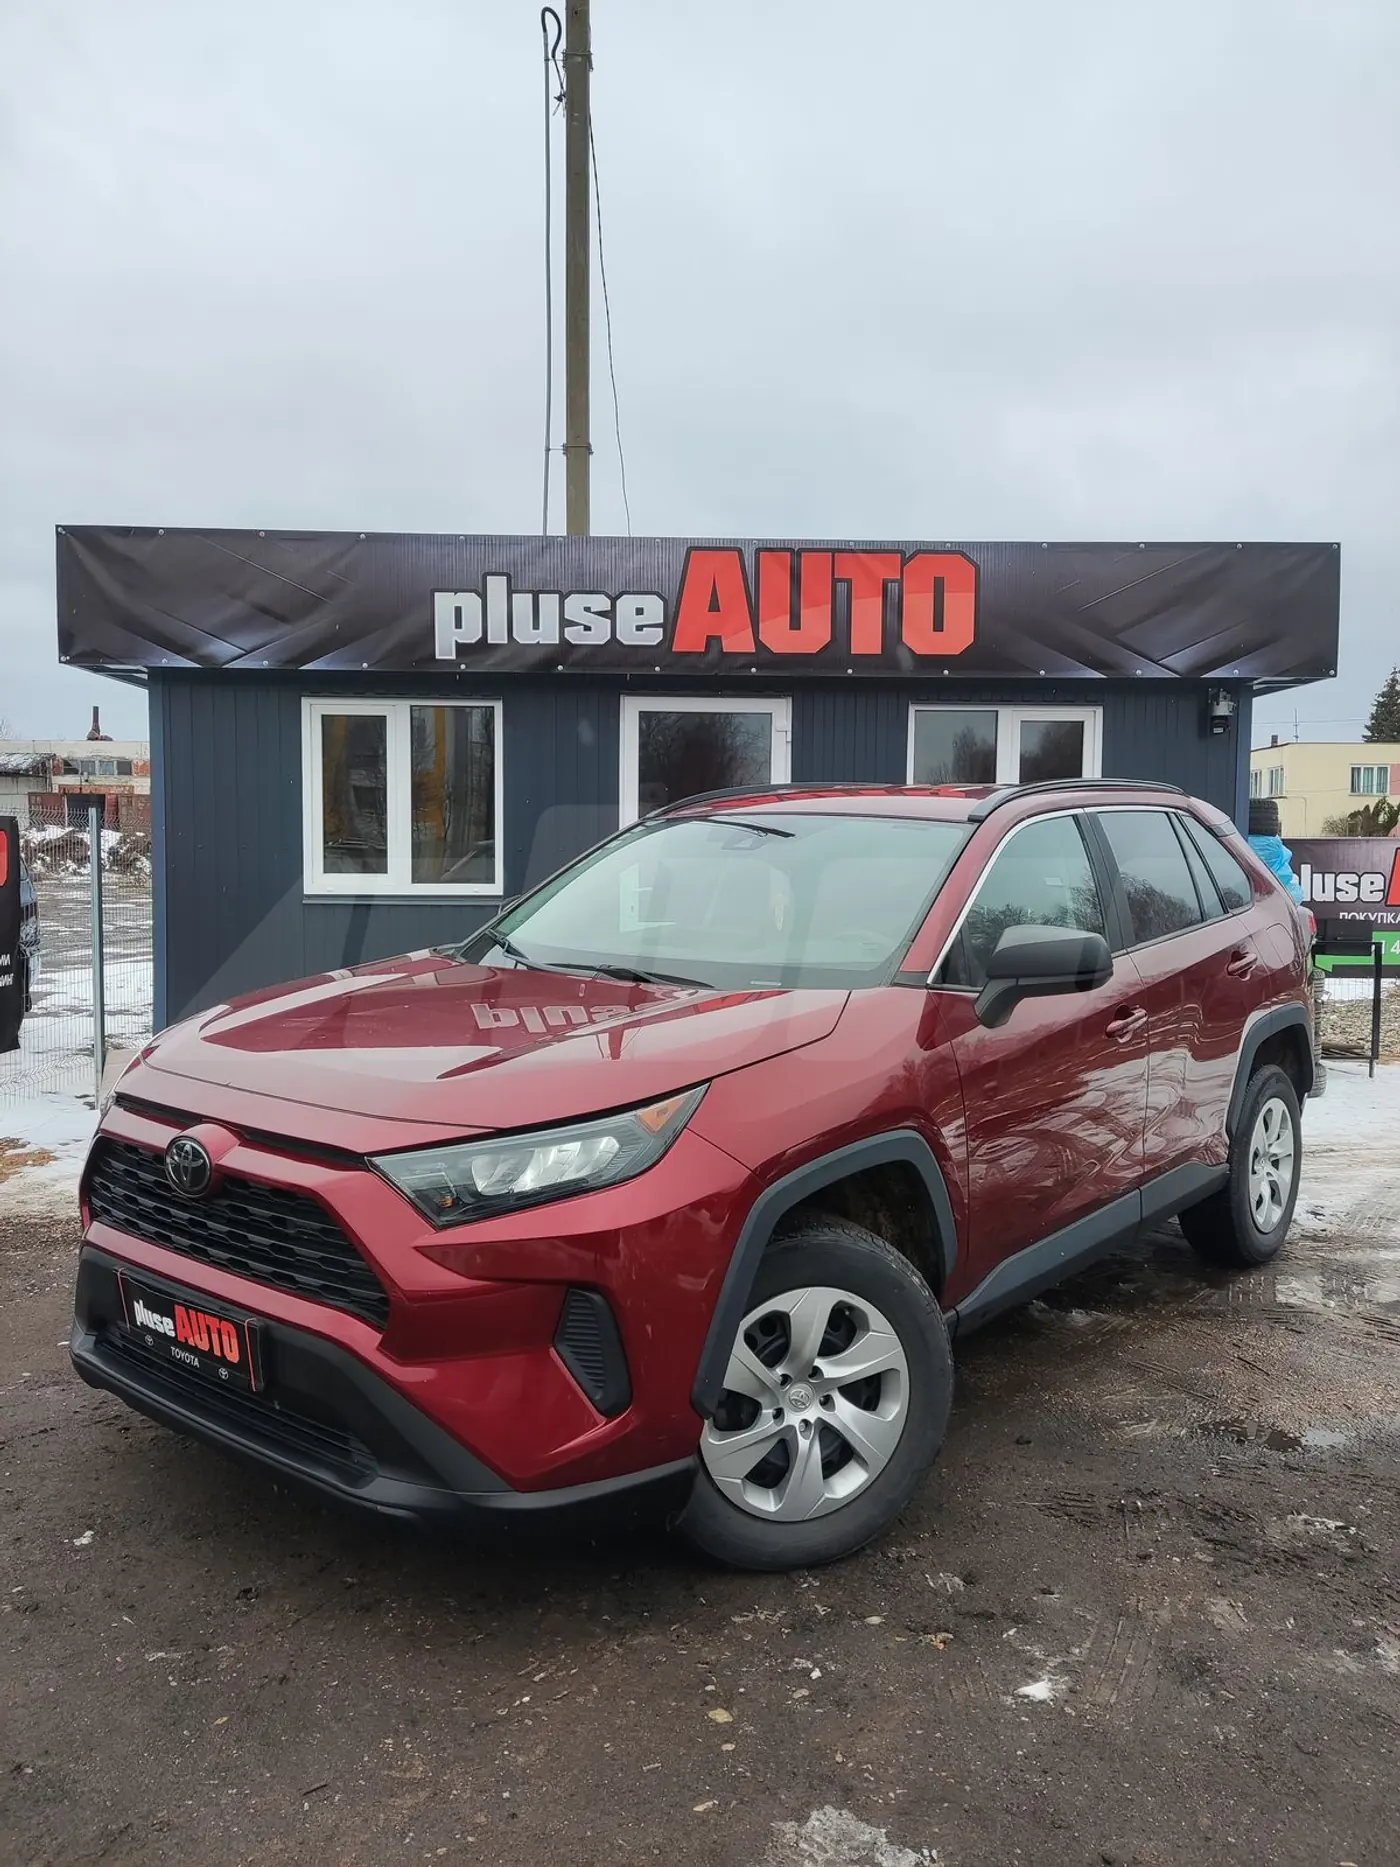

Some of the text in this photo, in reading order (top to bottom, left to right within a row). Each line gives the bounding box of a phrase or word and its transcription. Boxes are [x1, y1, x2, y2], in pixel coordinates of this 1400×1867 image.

[433, 547, 976, 660] pluseAUTO
[1300, 847, 1400, 905] luse
[133, 1299, 241, 1364] pluseAUTO
[170, 1346, 200, 1368] TOYOTA
